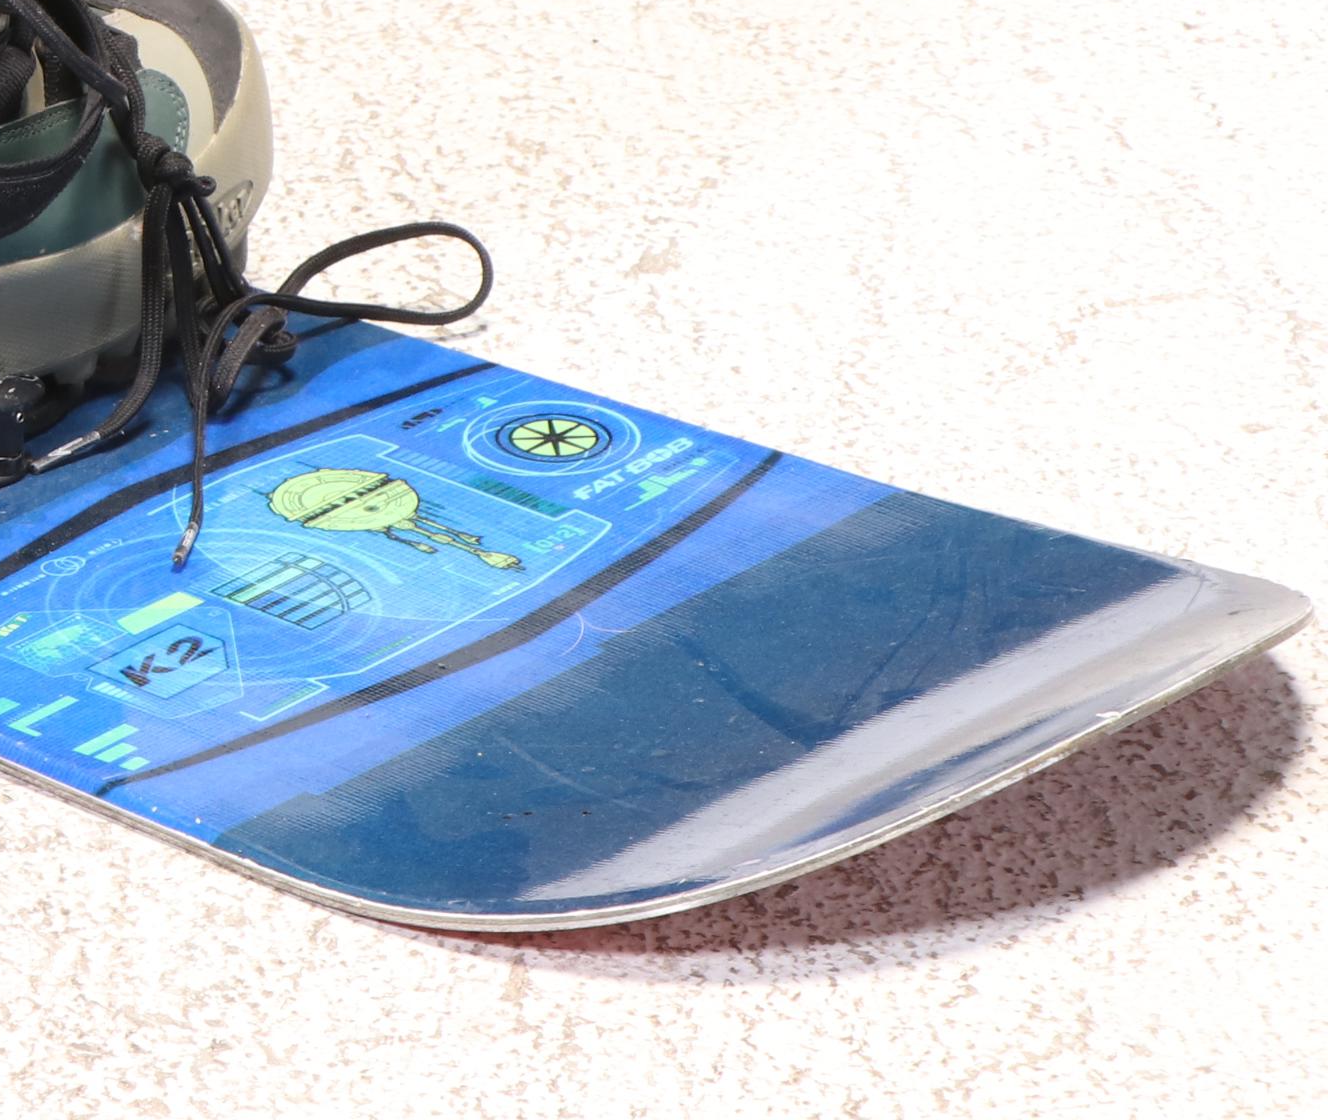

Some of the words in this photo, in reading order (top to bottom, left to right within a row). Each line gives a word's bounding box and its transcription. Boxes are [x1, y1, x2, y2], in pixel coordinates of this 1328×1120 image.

[573, 469, 626, 500] FAT
[625, 437, 694, 474] BOB
[120, 636, 220, 687] K2
